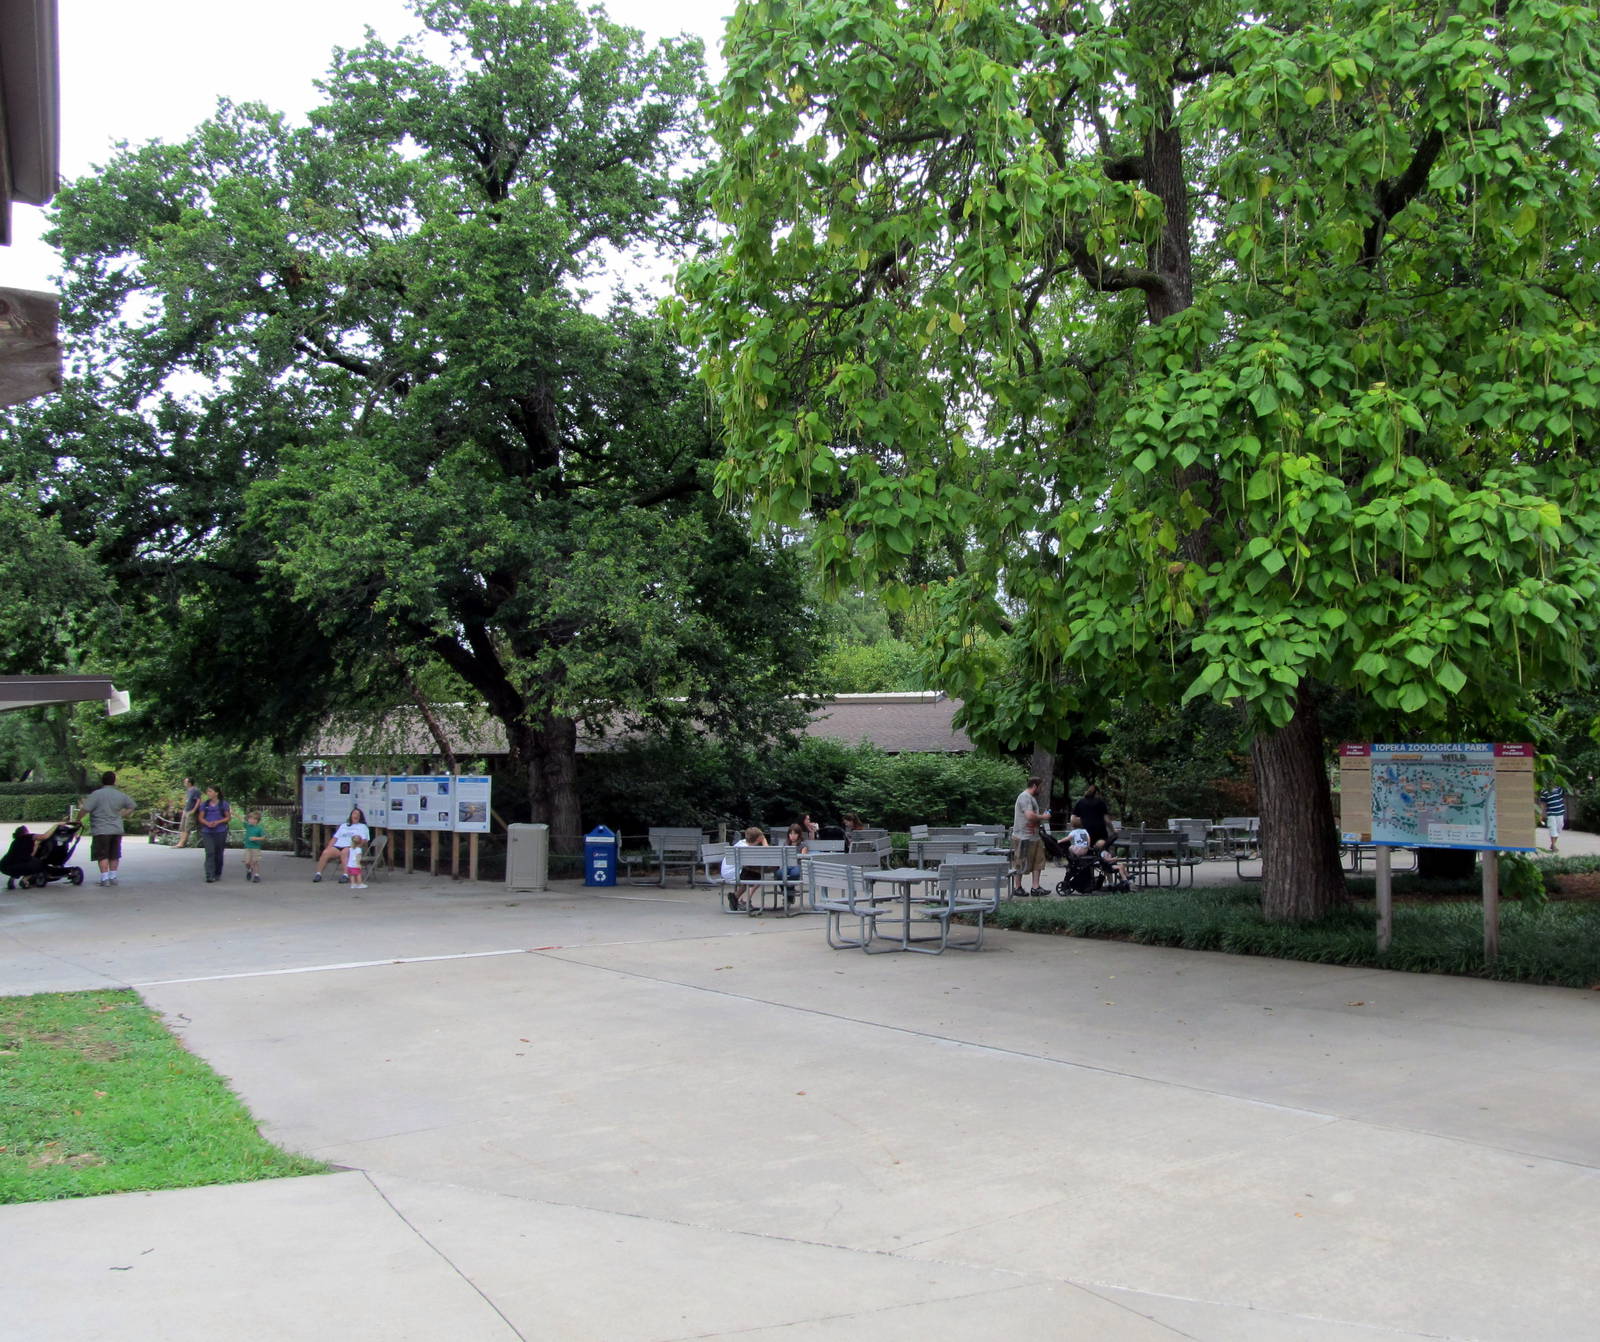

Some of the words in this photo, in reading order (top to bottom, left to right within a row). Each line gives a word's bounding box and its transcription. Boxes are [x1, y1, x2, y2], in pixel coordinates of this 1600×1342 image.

[1375, 743, 1406, 752] TOPEKA
[1408, 743, 1463, 752] ZOOLOGICAL
[1464, 743, 1489, 752] PARK
[1441, 753, 1467, 762] WILD
